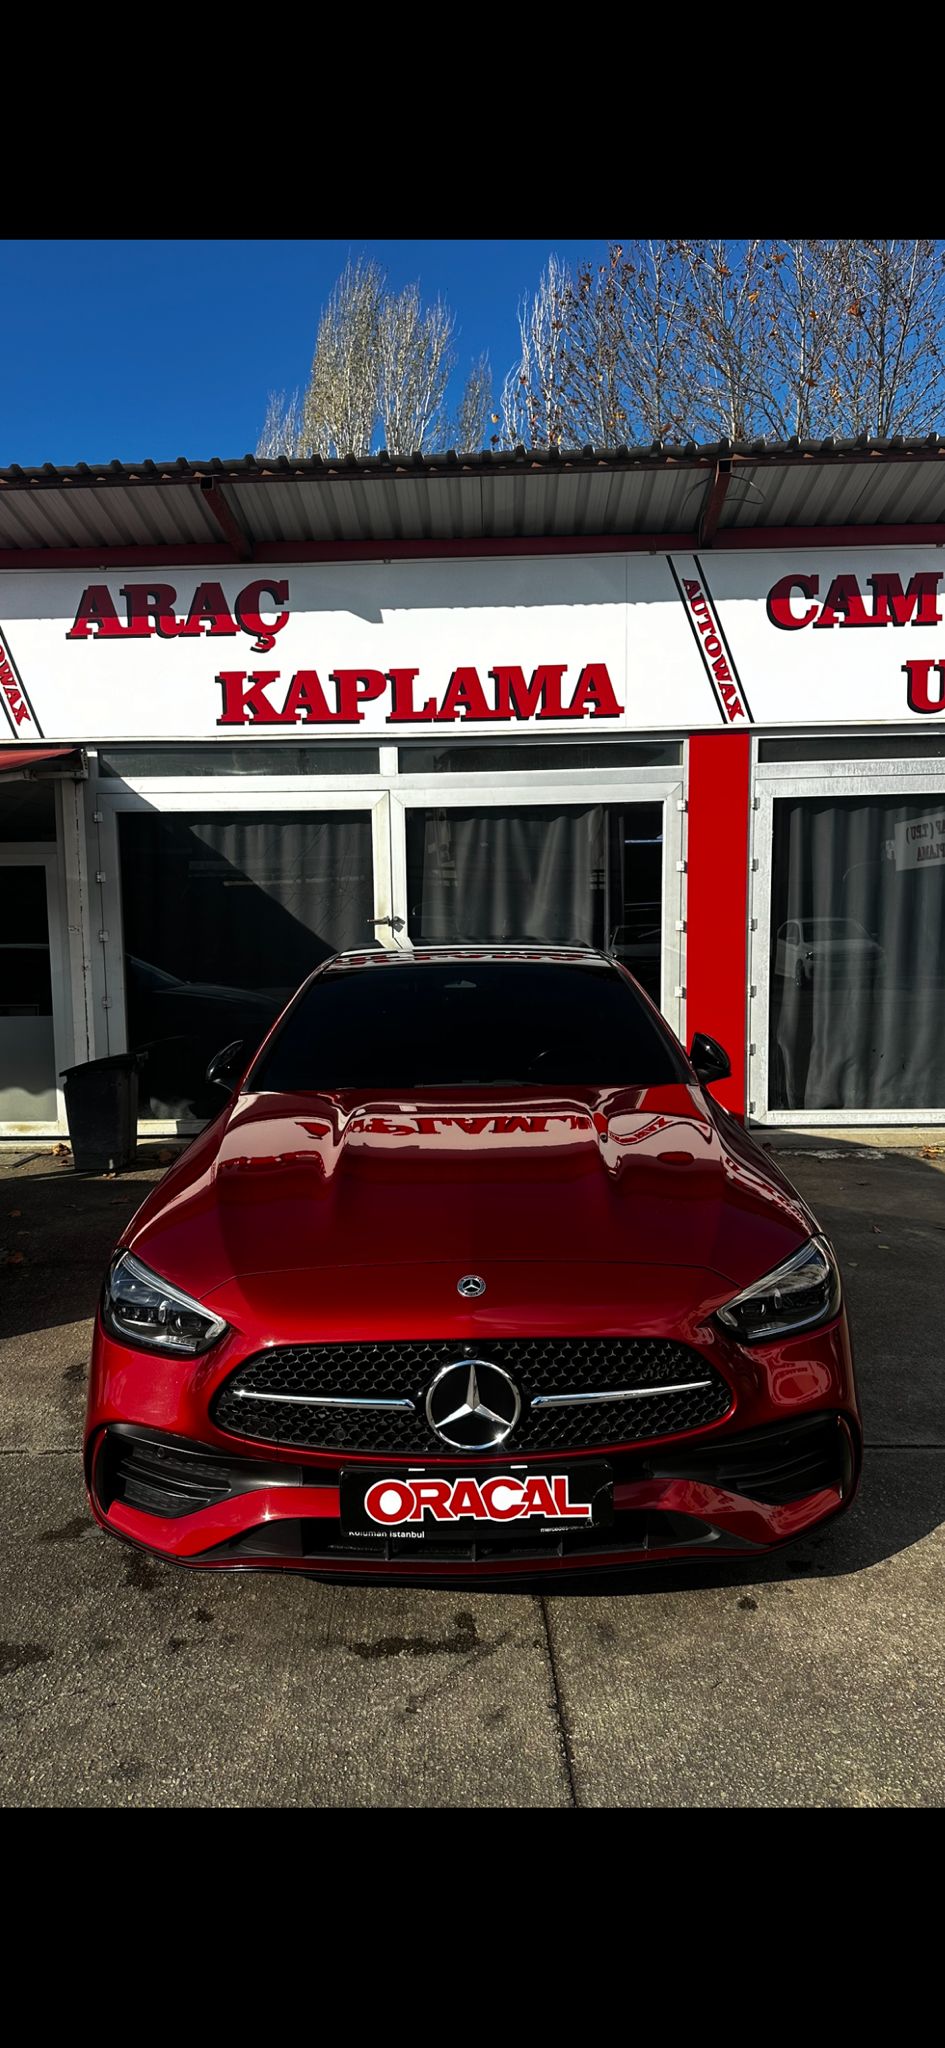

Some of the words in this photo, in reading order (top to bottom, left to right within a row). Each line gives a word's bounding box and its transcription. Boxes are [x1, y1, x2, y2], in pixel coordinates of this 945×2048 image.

[66, 579, 290, 653] ARAÇ
[766, 572, 944, 631] CAM
[682, 578, 745, 722] AUTOWAX
[215, 663, 625, 726] KAPLAMA
[364, 1475, 592, 1525] ORACAL
